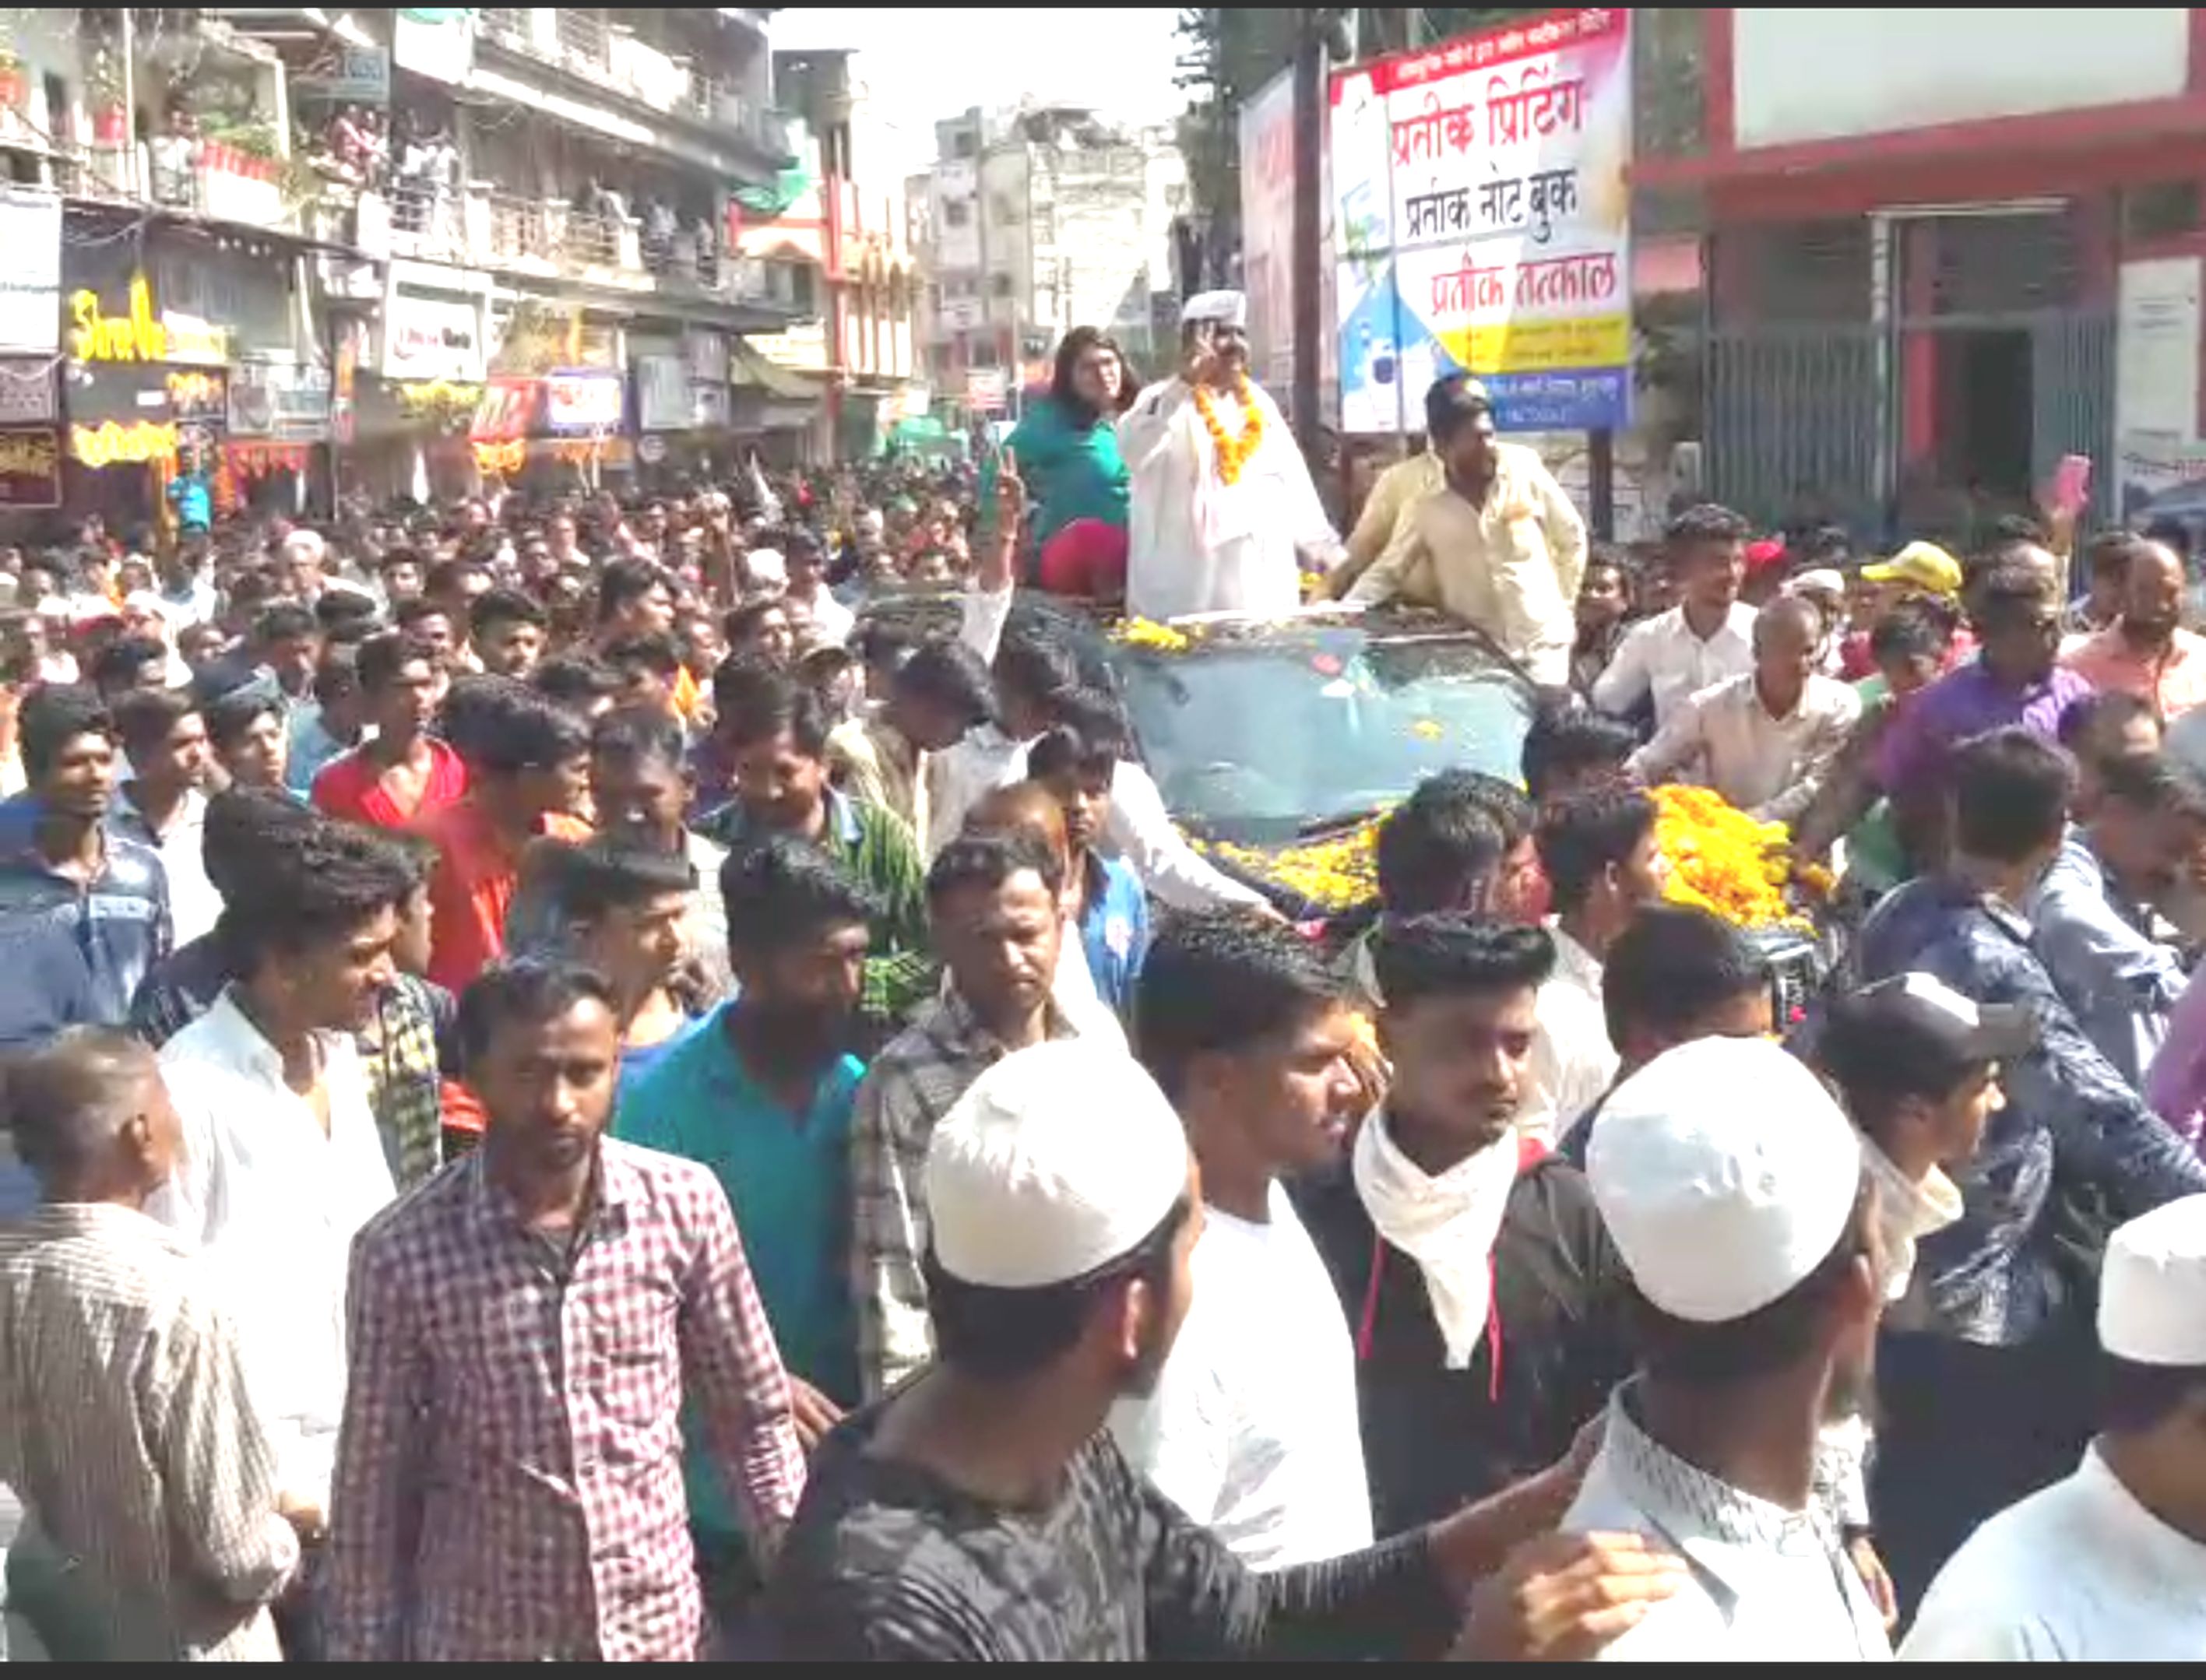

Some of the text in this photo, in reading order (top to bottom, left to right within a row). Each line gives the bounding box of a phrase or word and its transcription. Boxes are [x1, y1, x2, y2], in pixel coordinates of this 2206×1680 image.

[1528, 167, 1578, 244] बुक
[1431, 251, 1616, 316] प्रतीक तत्काल
